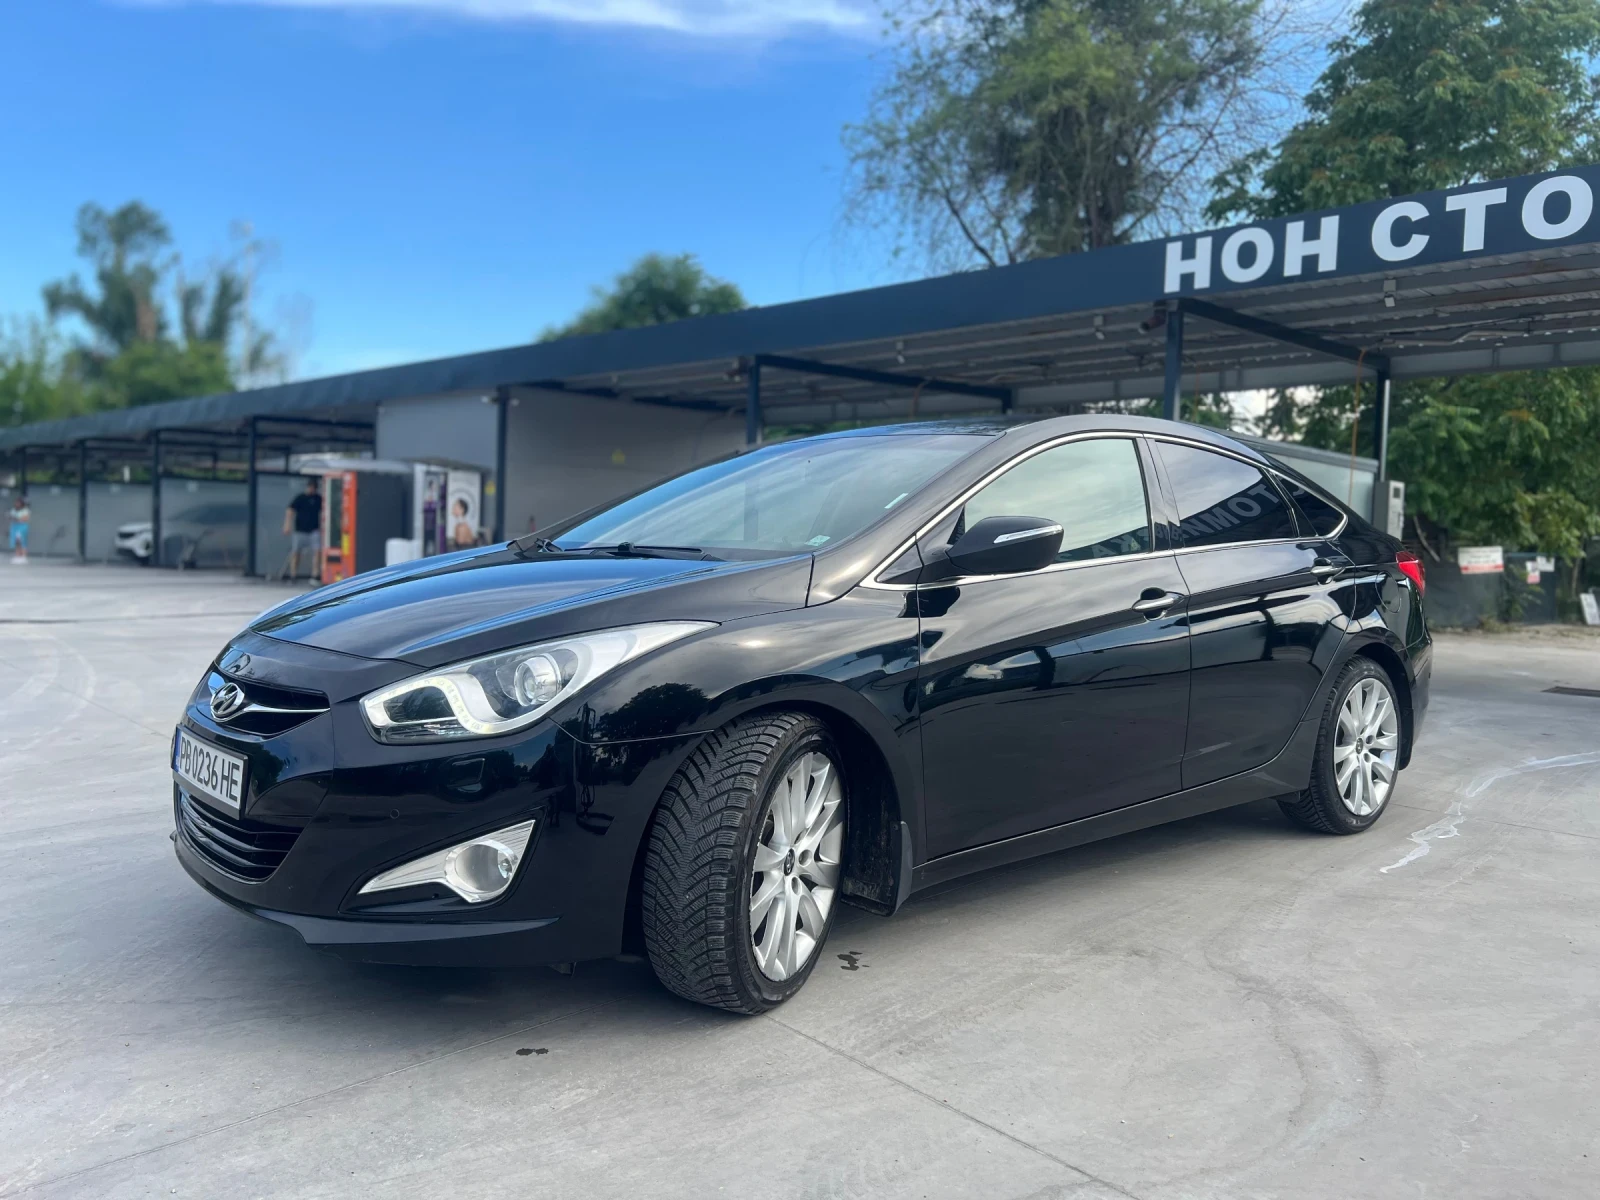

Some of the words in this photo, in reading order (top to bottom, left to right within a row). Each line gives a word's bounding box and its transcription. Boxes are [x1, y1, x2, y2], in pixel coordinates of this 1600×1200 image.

[1164, 215, 1339, 293] НОН
[1371, 175, 1594, 262] СТО
[180, 736, 192, 775] PB
[192, 744, 218, 791] 0236
[220, 758, 240, 802] HE
